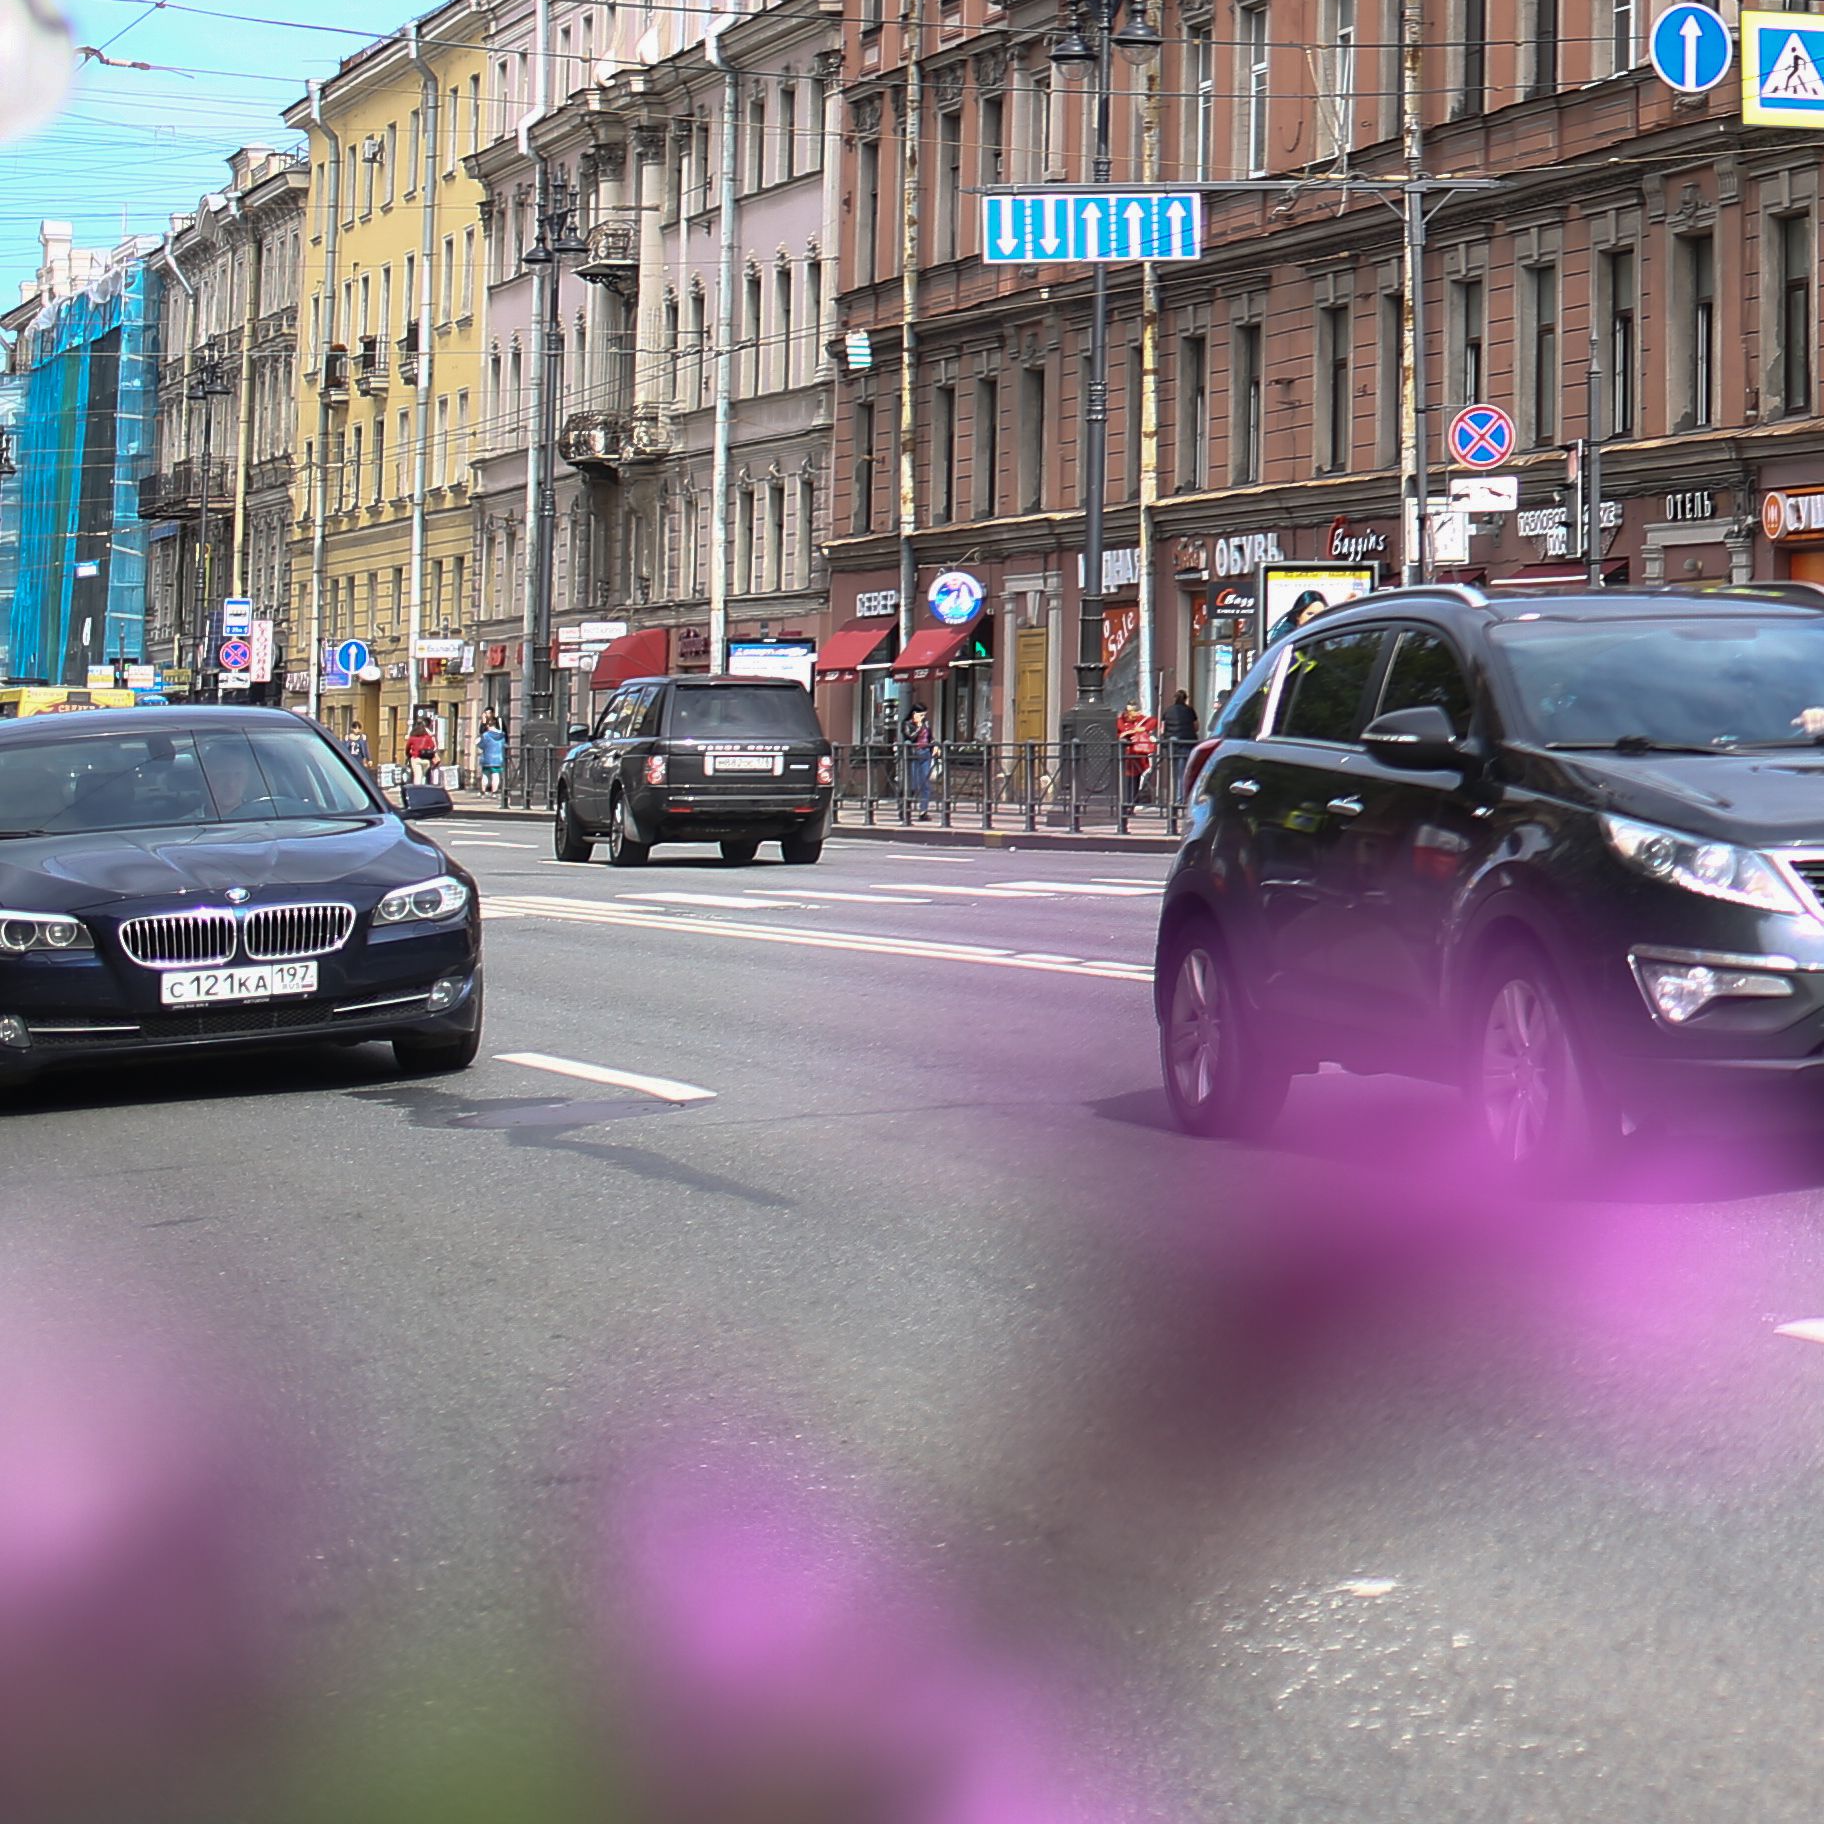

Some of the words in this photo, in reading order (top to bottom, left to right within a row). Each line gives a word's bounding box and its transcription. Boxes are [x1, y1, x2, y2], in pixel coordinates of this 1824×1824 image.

[1665, 490, 1713, 521] ОТЕЛЬ
[1215, 533, 1284, 576] ОБУВЬ
[1332, 528, 1386, 562] Baggins
[856, 591, 896, 617] СЕВЕР
[1107, 611, 1134, 663] Sale
[169, 973, 268, 999] С121КА
[275, 965, 310, 984] 197
